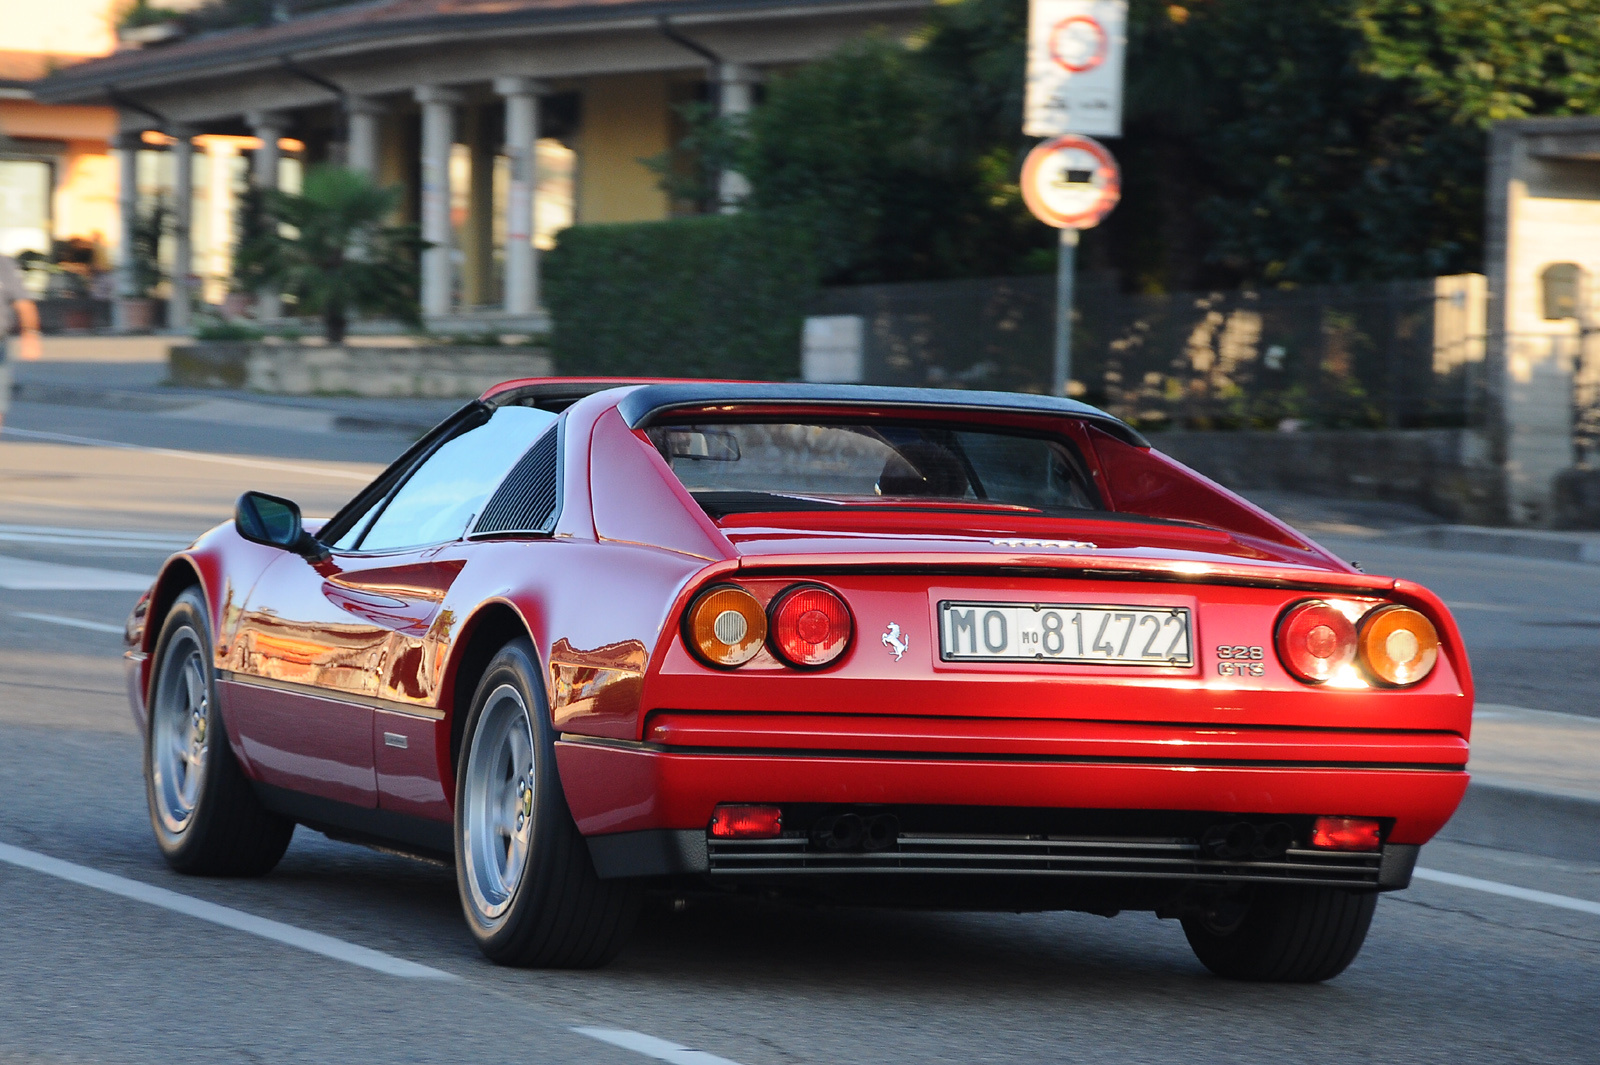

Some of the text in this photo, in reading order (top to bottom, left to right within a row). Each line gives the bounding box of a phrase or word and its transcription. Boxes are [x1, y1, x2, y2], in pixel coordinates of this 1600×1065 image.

[951, 609, 1187, 658] MO MO 814722
[1216, 645, 1265, 660] 328
[1217, 662, 1265, 677] GTS
